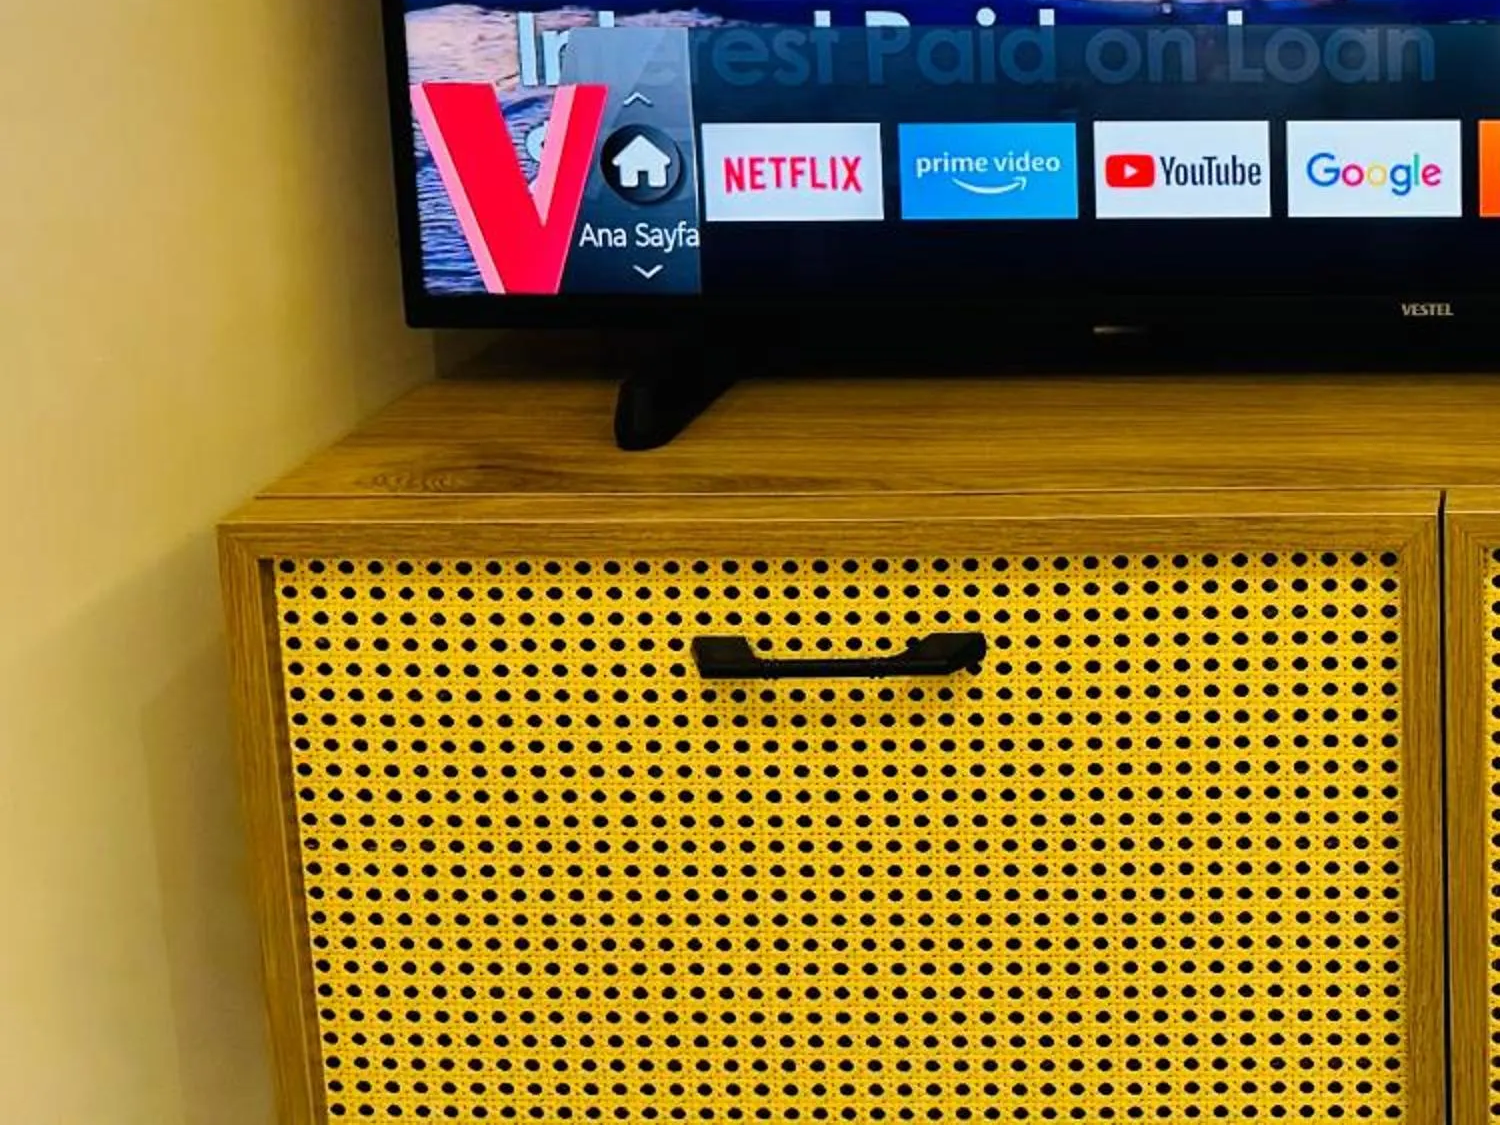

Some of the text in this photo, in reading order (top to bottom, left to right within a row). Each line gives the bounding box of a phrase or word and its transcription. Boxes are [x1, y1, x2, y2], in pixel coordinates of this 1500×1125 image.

[724, 156, 863, 194] NETFLIX
[916, 150, 1061, 178] prime video
[1160, 155, 1262, 187] YouTube
[1306, 152, 1442, 196] Google
[578, 221, 701, 255] Ana Sayfa
[1401, 303, 1454, 316] VESTEL
